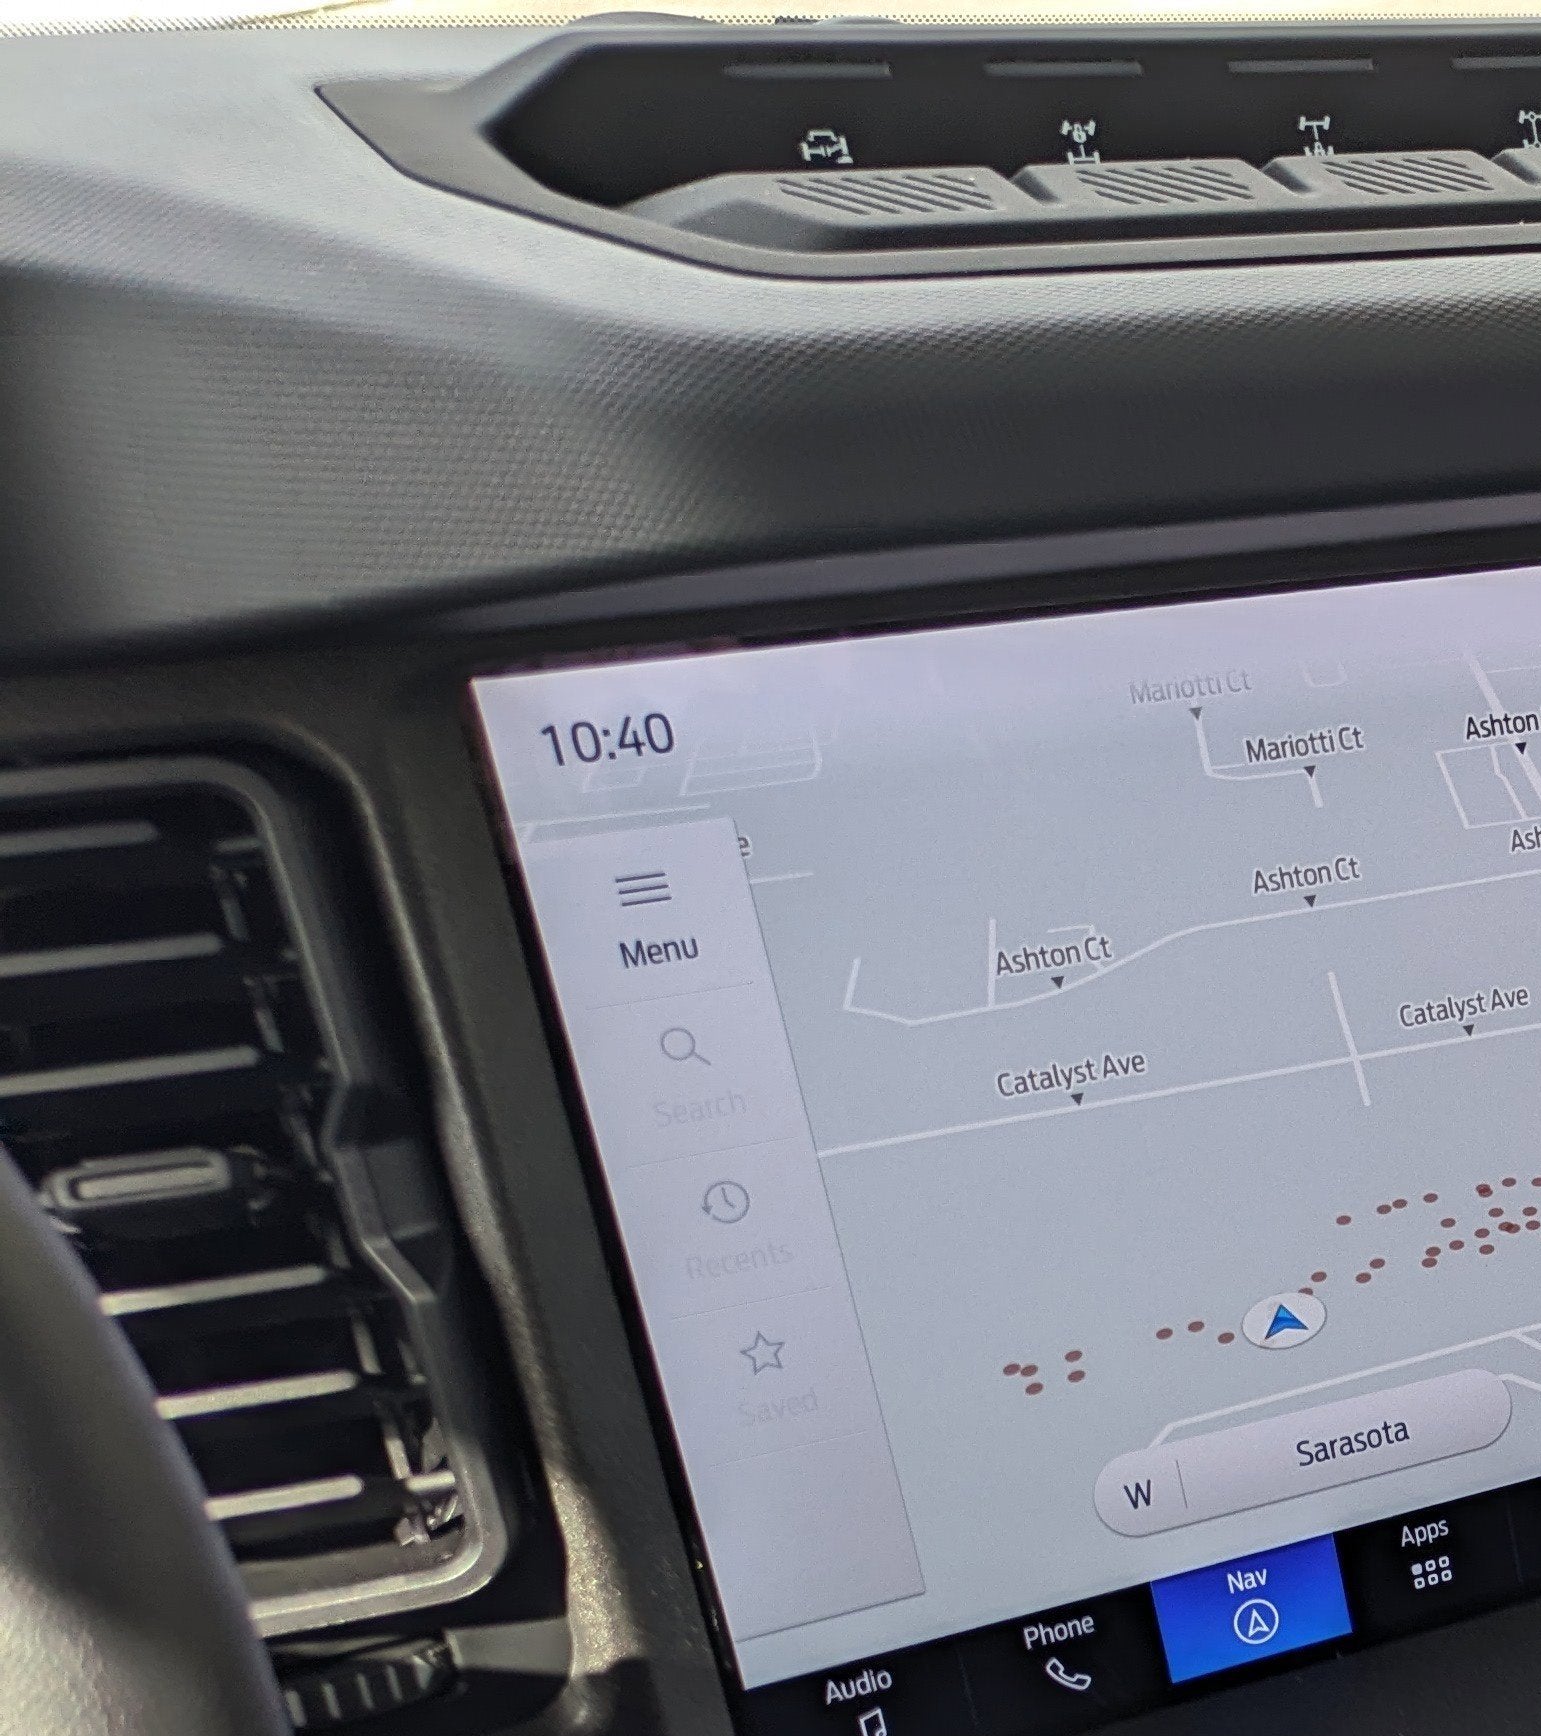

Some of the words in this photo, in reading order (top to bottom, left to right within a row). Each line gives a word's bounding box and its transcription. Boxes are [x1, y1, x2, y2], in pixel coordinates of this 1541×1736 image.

[1130, 675, 1222, 705] Mariotti
[1225, 669, 1253, 695] Ct
[541, 712, 676, 767] 10:40
[1464, 708, 1538, 741] Ashton
[1245, 729, 1336, 766] Mariotti
[1339, 725, 1365, 753] Ct
[1251, 861, 1331, 895] Ashton
[1333, 857, 1360, 882] Ct
[620, 935, 699, 969] Menu
[996, 941, 1081, 976] Ashton
[1084, 936, 1113, 962] Ct
[1398, 993, 1484, 1032] Catalyst
[1487, 986, 1530, 1012] Ave
[997, 1053, 1098, 1098] Catalyst
[1101, 1050, 1146, 1080] Ave
[653, 1091, 747, 1128] Search
[686, 1243, 794, 1280] Recents
[1295, 1418, 1410, 1468] Sarasota
[1124, 1480, 1153, 1509] W
[1400, 1515, 1450, 1551] Apps
[1226, 1566, 1270, 1592] Nav
[1023, 1611, 1096, 1650] Phone
[824, 1667, 893, 1706] Audio
